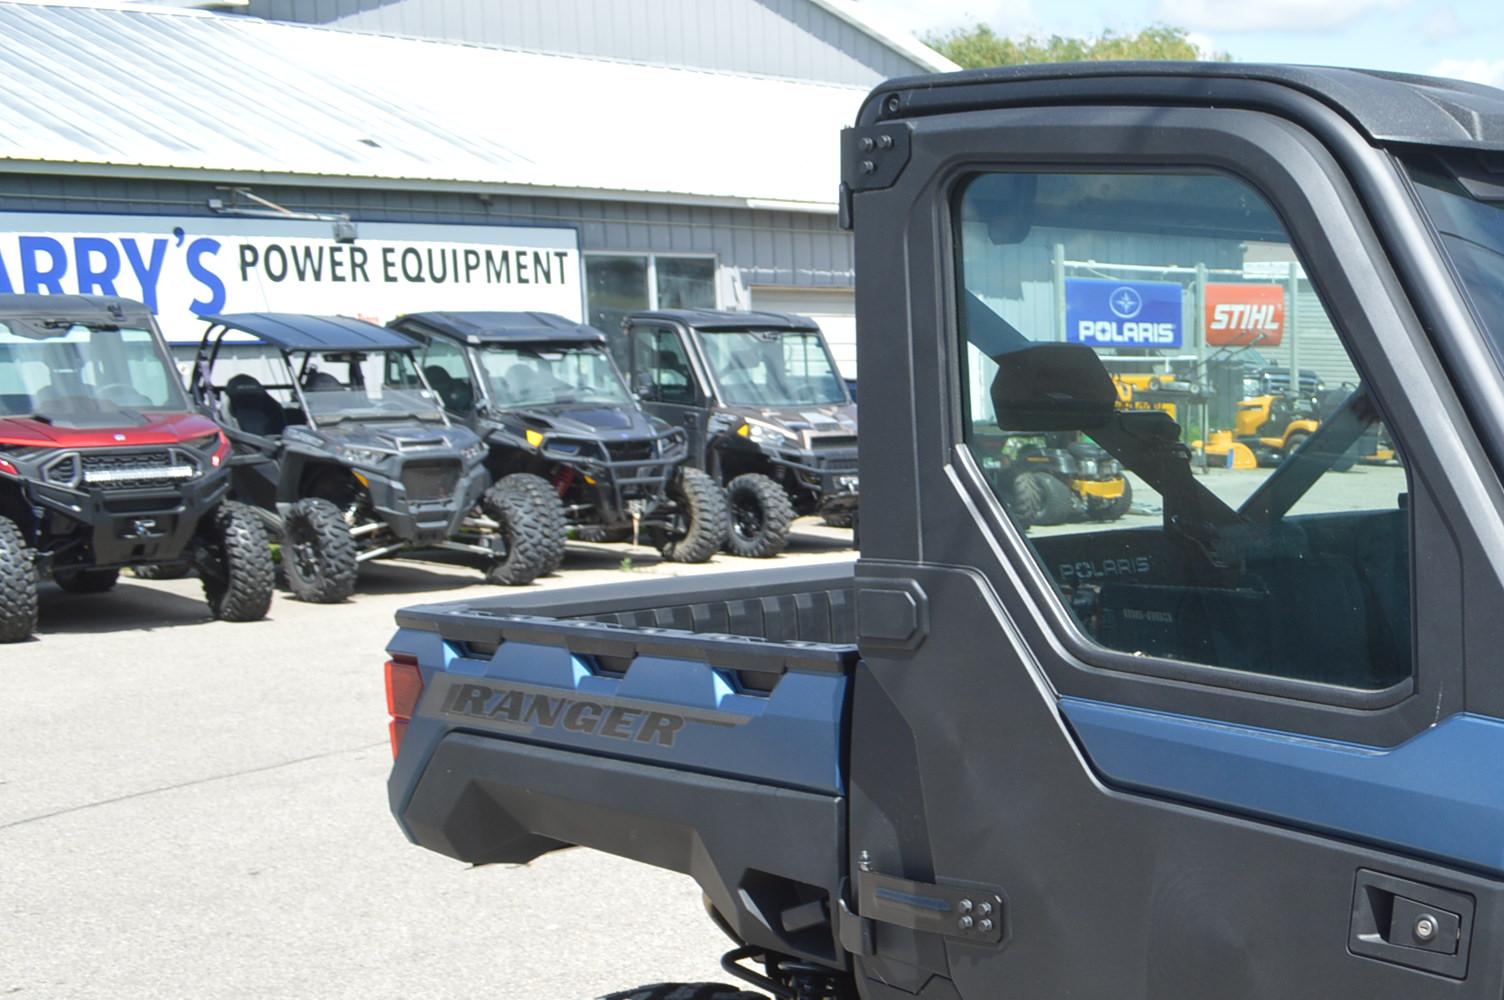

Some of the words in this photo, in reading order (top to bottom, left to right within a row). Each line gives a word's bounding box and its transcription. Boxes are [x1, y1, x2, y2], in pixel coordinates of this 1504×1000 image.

[0, 226, 227, 317] RRY'S
[239, 243, 371, 282] POWER
[382, 246, 568, 285] EQUIPMENT
[1210, 303, 1280, 330] STIHL
[1079, 320, 1175, 344] POLARIS
[1060, 556, 1150, 579] POLARIS
[448, 683, 685, 748] RANGER
